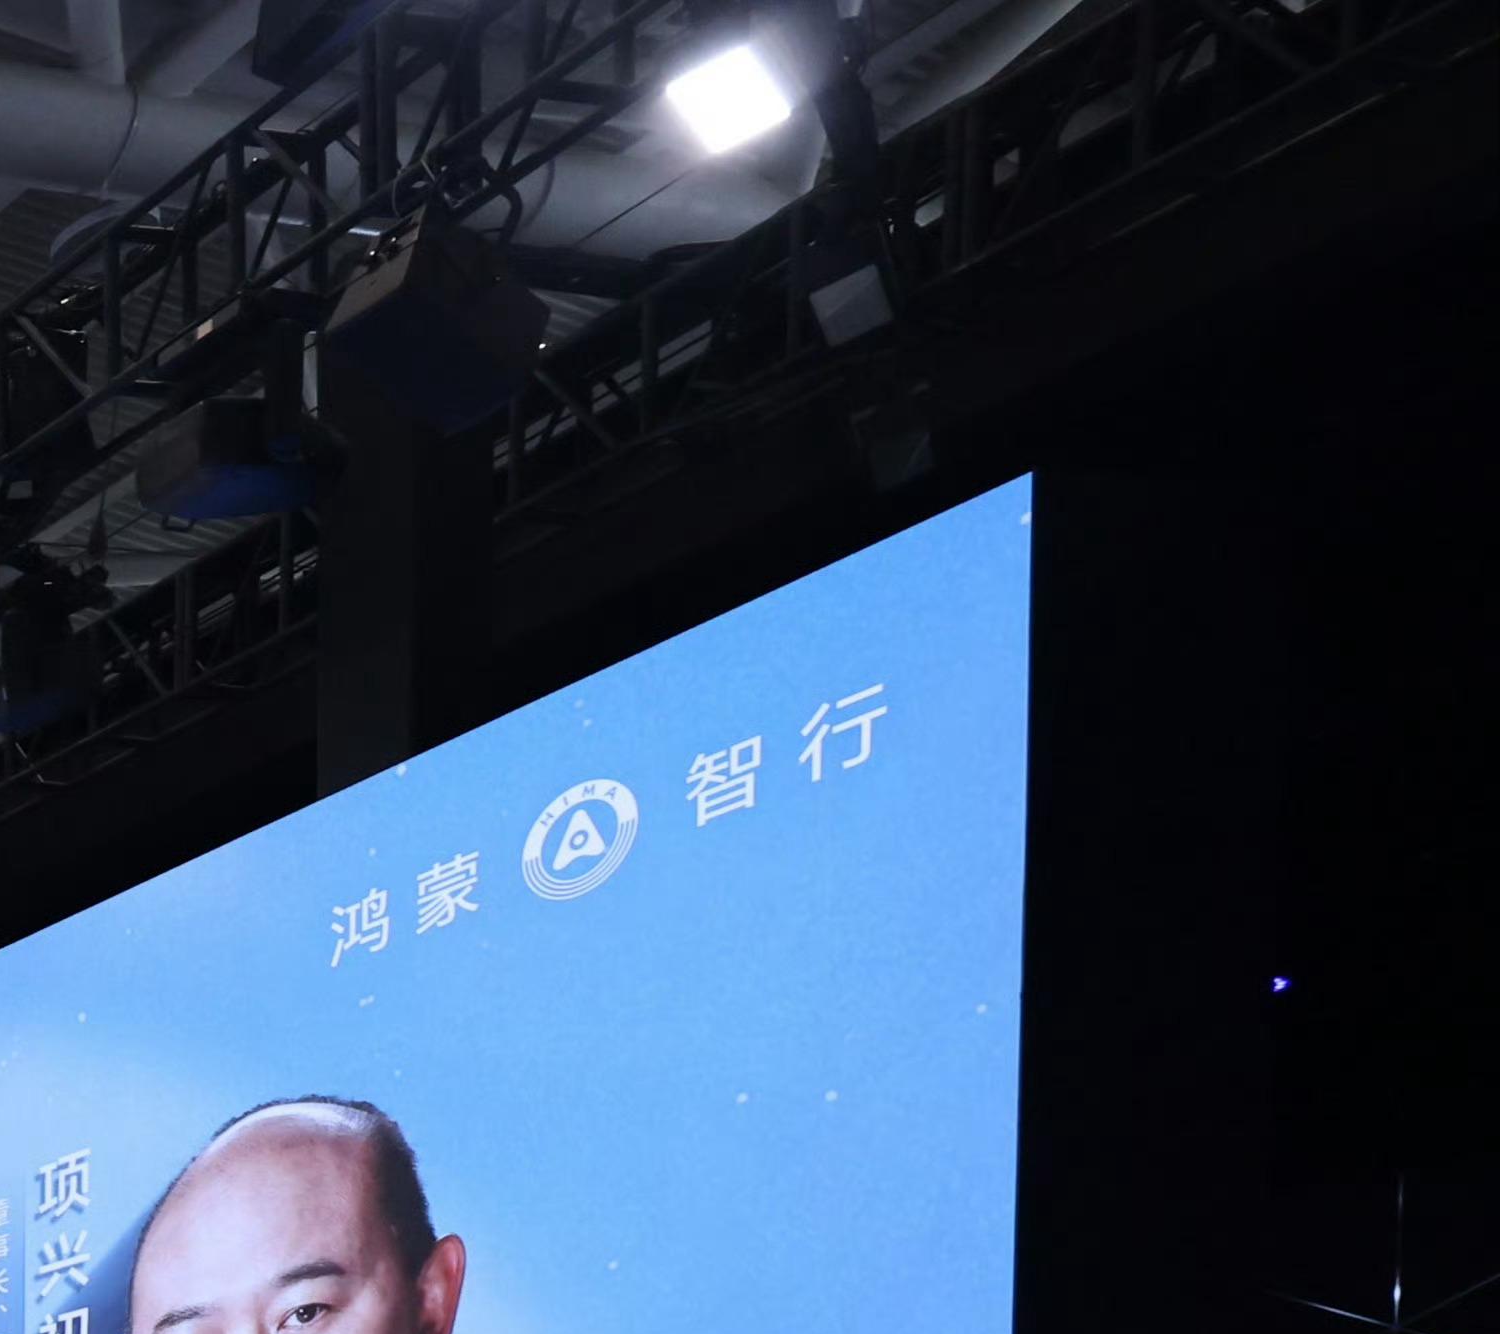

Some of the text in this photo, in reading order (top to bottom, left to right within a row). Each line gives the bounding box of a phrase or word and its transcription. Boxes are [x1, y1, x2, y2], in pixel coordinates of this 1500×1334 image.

[330, 683, 889, 968] 鸿蒙 智行
[540, 783, 618, 826] HIMA
